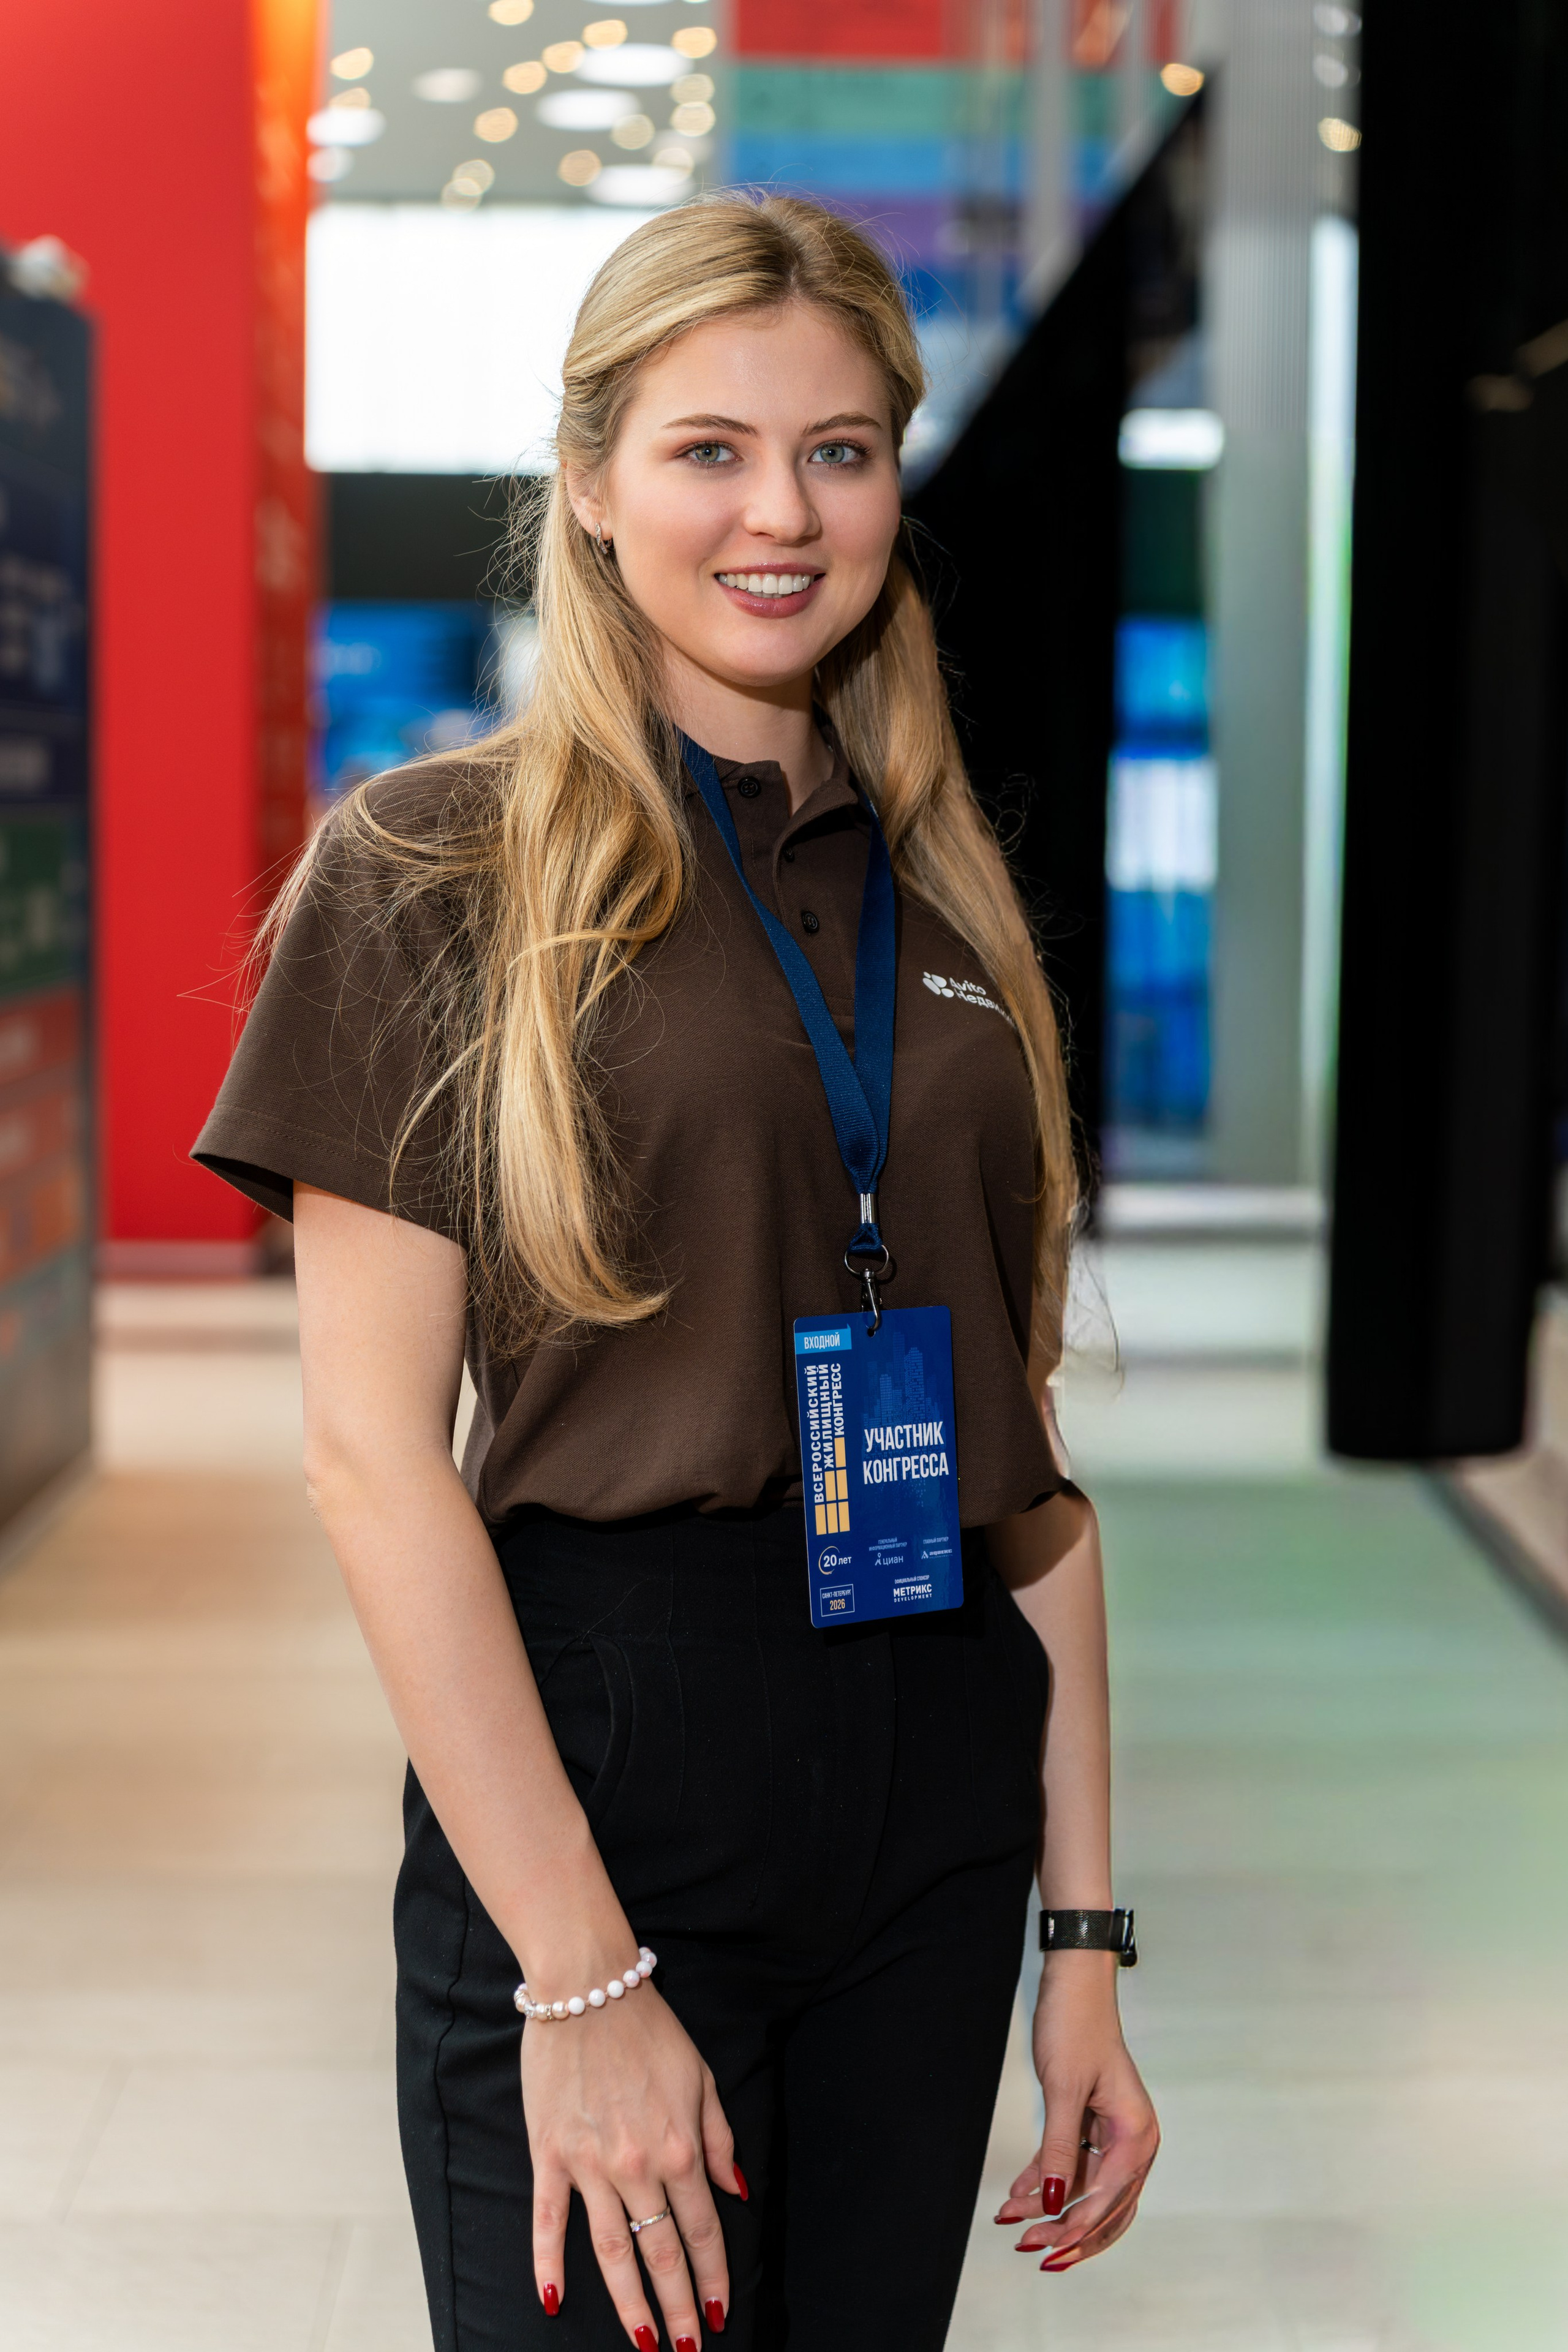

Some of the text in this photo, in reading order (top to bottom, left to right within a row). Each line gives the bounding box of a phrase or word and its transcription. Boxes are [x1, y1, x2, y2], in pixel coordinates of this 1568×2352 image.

[949, 977, 986, 995] Avito
[804, 1332, 840, 1349] ВХОДНОЙ
[831, 1363, 845, 1436] КОНГРЕСС
[816, 1364, 834, 1469] ЖИЛИЩНЫЙ
[804, 1365, 824, 1503] ВСЕРОССИЙСКИЙ
[864, 1421, 944, 1452] УЧАСТНИК
[863, 1452, 949, 1485] КОНГРЕССА
[823, 1554, 852, 1567] 20 лет
[883, 1556, 903, 1566] циан
[821, 1589, 851, 1599] САНКТ-ПЕТЕРБУРГ
[893, 1583, 932, 1597] МЕТРИКС
[894, 1593, 932, 1603] DEVELOPMENT
[829, 1598, 845, 1611] 2026
